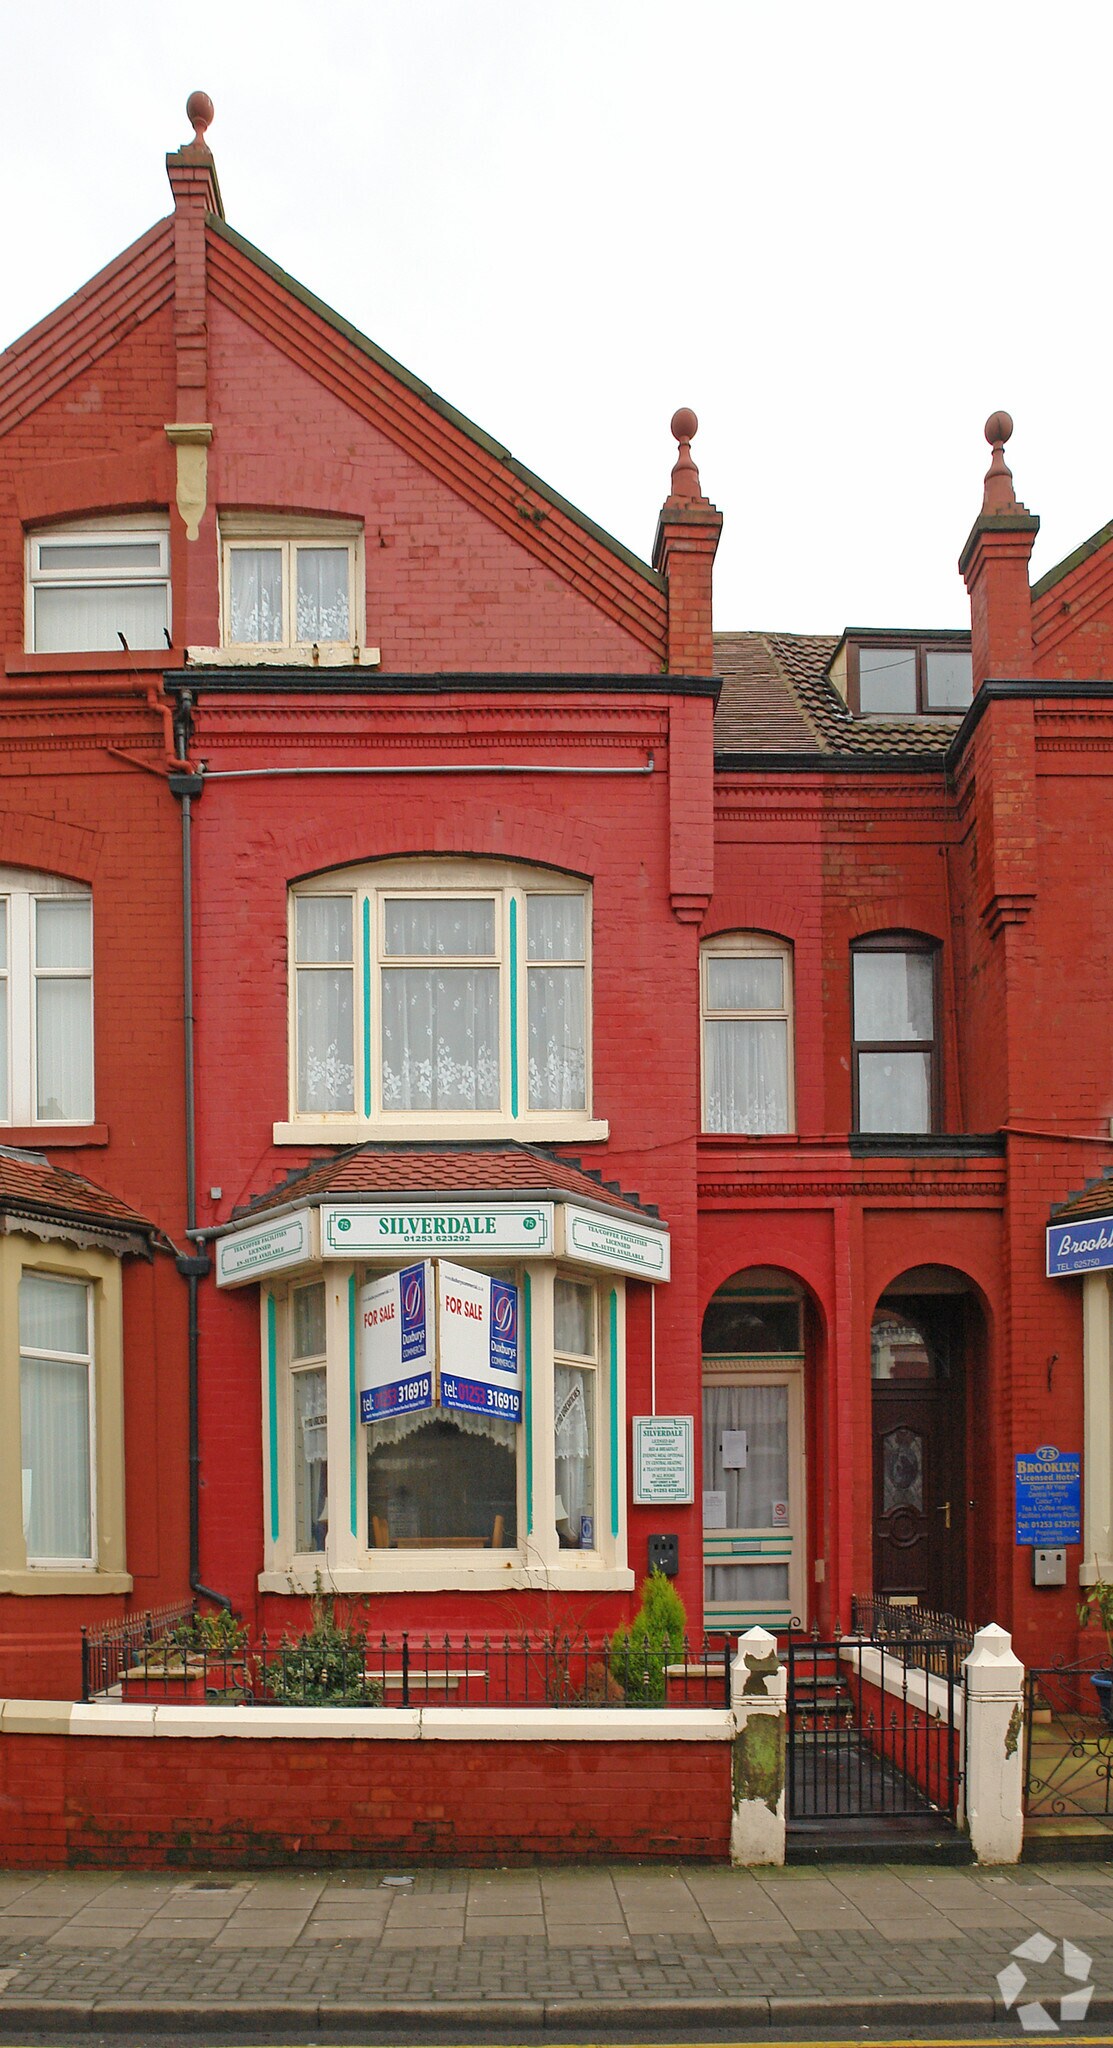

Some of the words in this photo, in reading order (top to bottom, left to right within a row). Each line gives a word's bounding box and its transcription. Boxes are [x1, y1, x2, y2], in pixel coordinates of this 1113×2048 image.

[340, 1221, 349, 1229] 75
[379, 1217, 496, 1234] SILVERDALE
[526, 1220, 534, 1228] 75
[262, 1231, 287, 1243] FACILITIES
[588, 1226, 619, 1239] TEA/COFFEE
[621, 1234, 647, 1247] FACILITIES
[606, 1238, 631, 1249] LICENSED
[237, 1255, 257, 1266] EN-SUITE
[259, 1247, 284, 1258] AVAILABLE
[249, 1244, 271, 1255] LICENSED
[592, 1242, 616, 1253] EN-SUITE
[617, 1249, 644, 1260] AVAILABLE
[1074, 1258, 1099, 1269] 625750
[446, 1295, 462, 1315] FOR
[464, 1301, 482, 1320] SALE
[364, 1309, 378, 1328] FOR
[380, 1303, 394, 1323] SALE
[403, 1330, 425, 1345] Duxburys
[403, 1344, 425, 1358] COMMERCIAL
[491, 1340, 516, 1359] Duxburys
[491, 1356, 516, 1369] COMMERCIAL
[363, 1394, 374, 1412] tel:
[374, 1388, 397, 1408] 01253
[398, 1379, 428, 1403] 316919
[444, 1381, 457, 1398] tel:
[458, 1382, 485, 1404] 01253
[487, 1390, 519, 1411] 316919
[1041, 1450, 1054, 1459] 73
[1017, 1461, 1079, 1473] BROOKLYN
